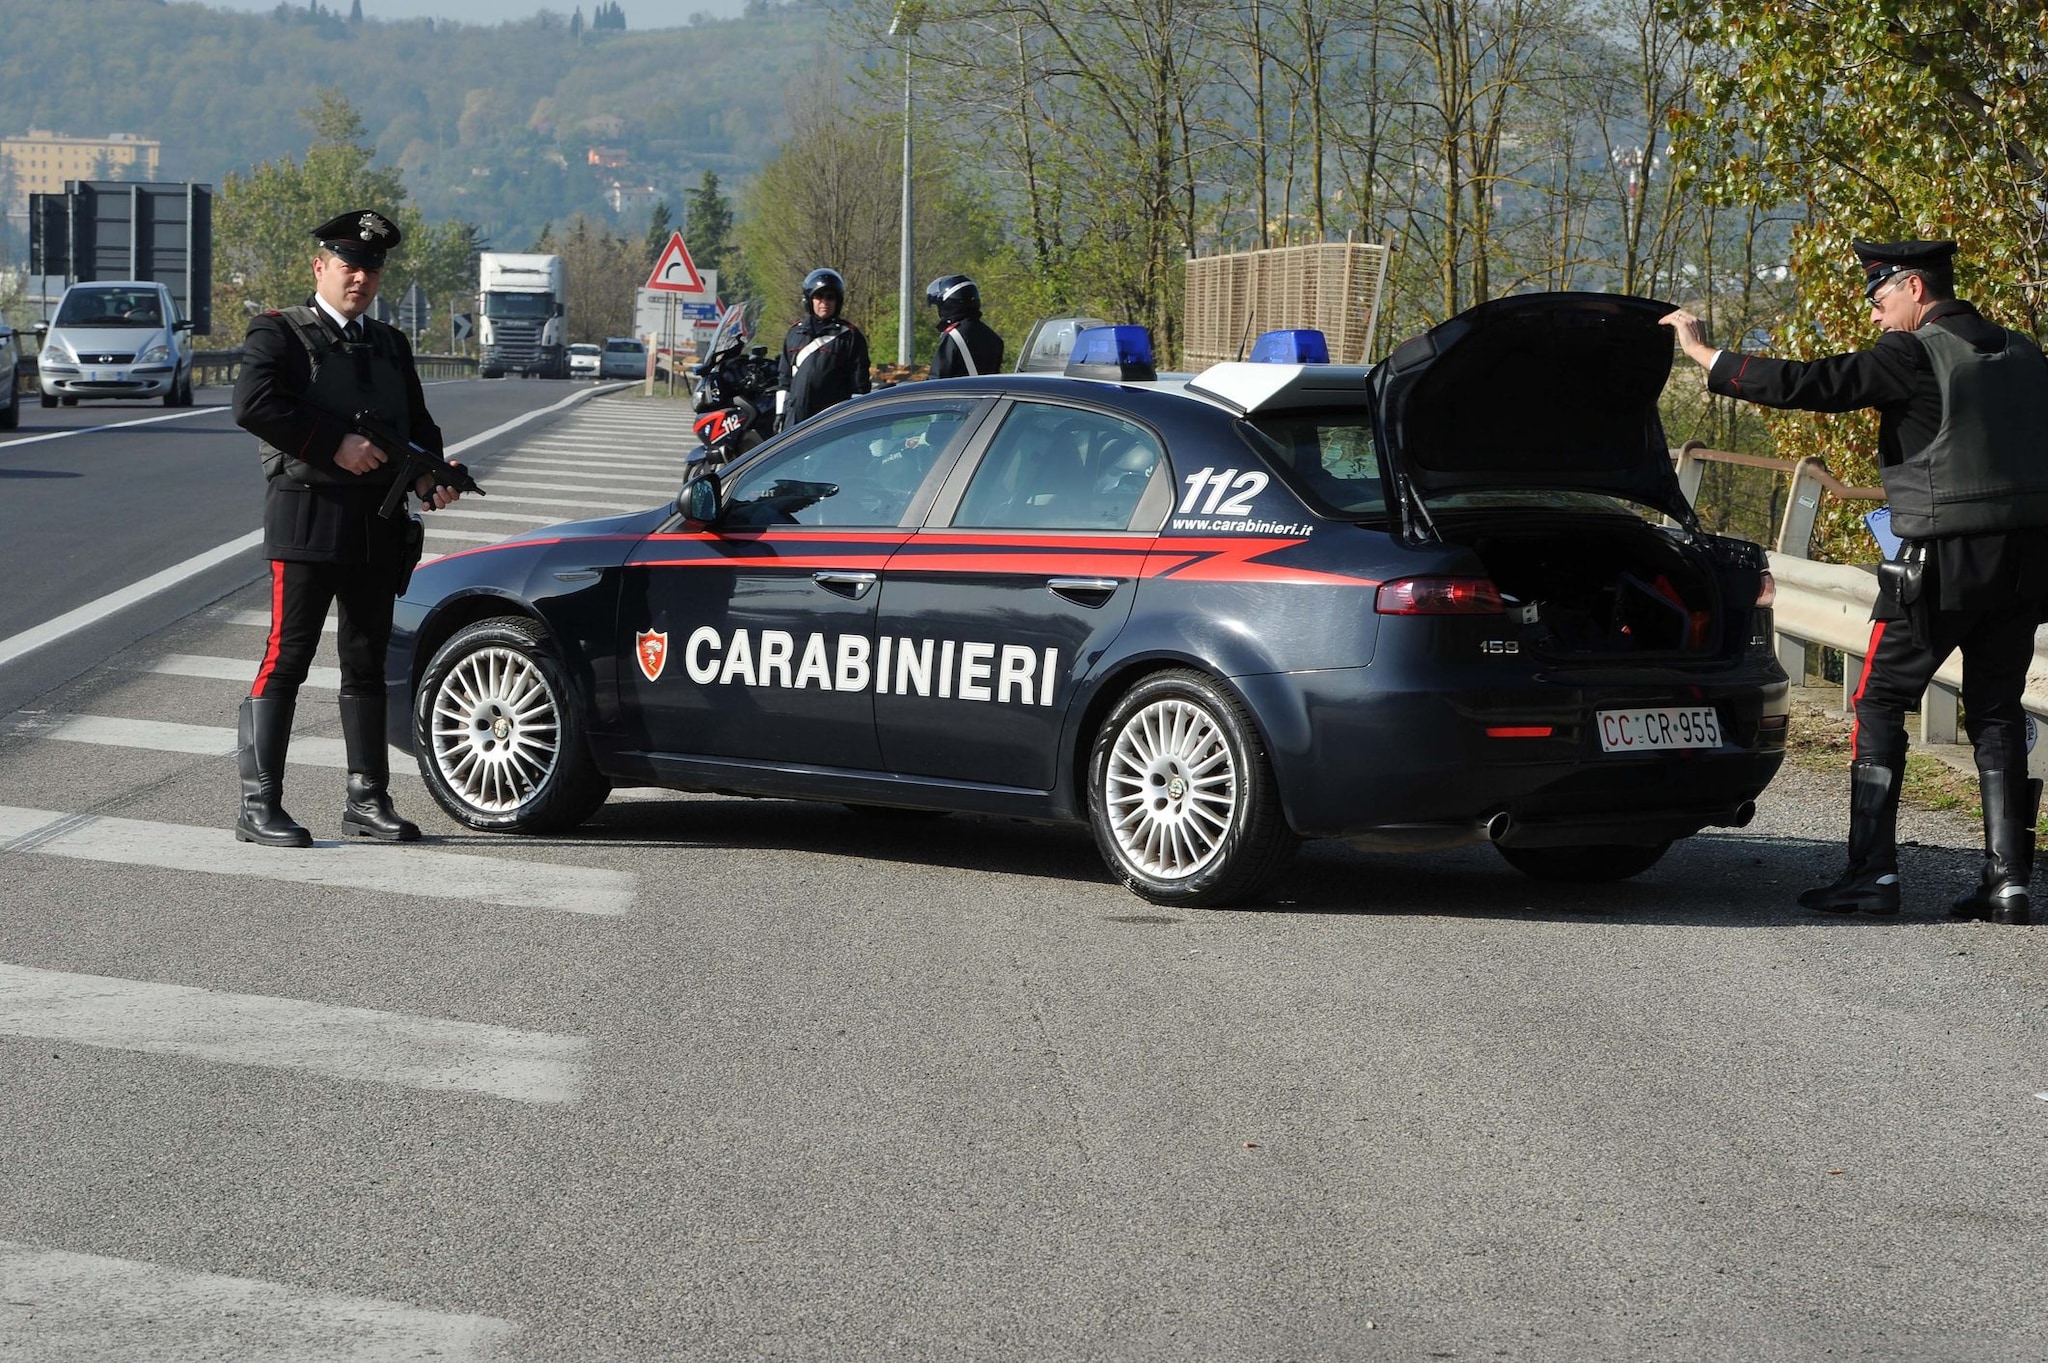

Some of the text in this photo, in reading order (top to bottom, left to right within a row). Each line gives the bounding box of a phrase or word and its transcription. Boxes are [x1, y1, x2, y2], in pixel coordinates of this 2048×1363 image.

[722, 414, 741, 434] 112
[1178, 466, 1270, 517] 112
[1172, 518, 1314, 537] www.carabinieri.it
[1480, 640, 1519, 654] 159
[685, 625, 1059, 707] CARABINIERI
[1603, 712, 1718, 746] CC CR 955
